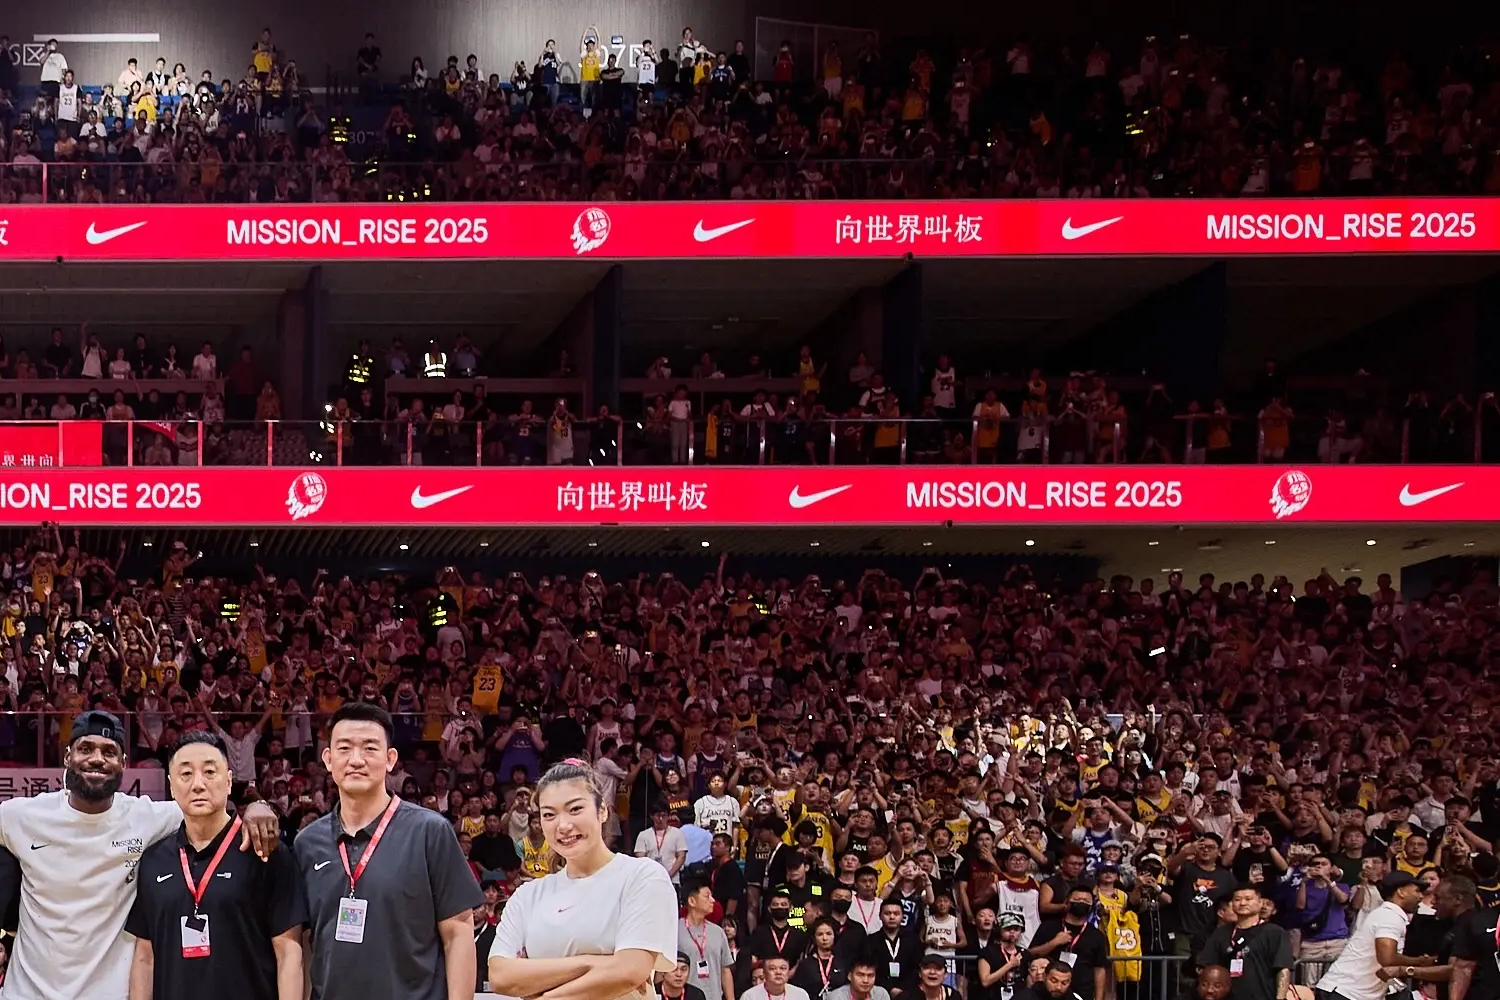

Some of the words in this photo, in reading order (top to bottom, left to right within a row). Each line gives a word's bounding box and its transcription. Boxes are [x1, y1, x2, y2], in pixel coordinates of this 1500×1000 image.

[227, 219, 416, 245] MISSION_RISE
[424, 218, 488, 243] 2025
[835, 214, 983, 243] 向世界叫板
[1207, 213, 1402, 240] MISSION_RISE
[1409, 212, 1476, 238] 2025
[135, 483, 202, 508] 2025
[557, 481, 708, 511] 向世界叫板
[906, 481, 1106, 508] MISSION_RISE
[1114, 481, 1182, 507] 2025
[38, 575, 48, 584] 23
[478, 678, 496, 692] 23
[707, 809, 731, 818] LAKERS
[111, 838, 143, 849] MISSION
[125, 859, 139, 868] 202
[1114, 928, 1139, 951] 23
